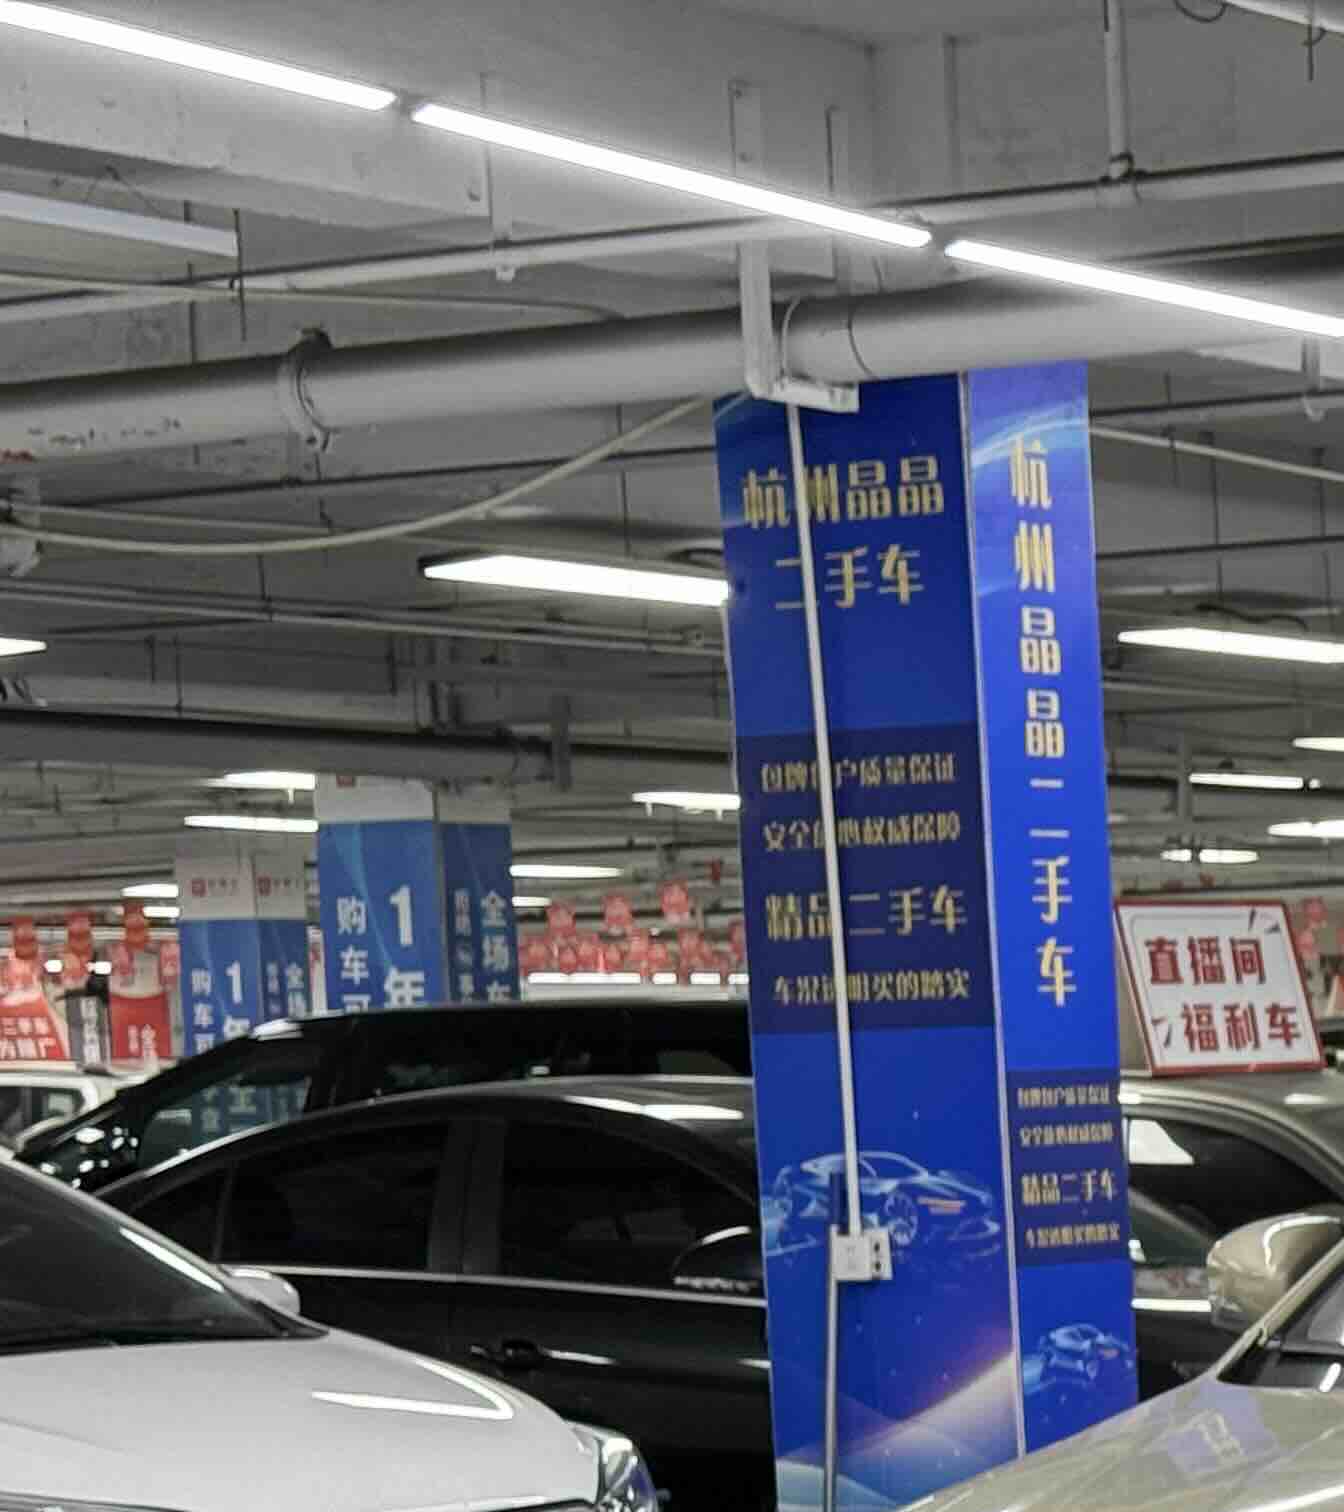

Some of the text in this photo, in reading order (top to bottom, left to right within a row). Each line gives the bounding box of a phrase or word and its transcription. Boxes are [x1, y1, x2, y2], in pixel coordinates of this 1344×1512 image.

[743, 455, 945, 529] 杭州晶晶
[775, 543, 924, 609] 二手车
[1009, 438, 1076, 1007] 杭州晶晶二手车
[766, 885, 968, 941] 精品二手车
[1144, 936, 1266, 985] 直播间
[1181, 1002, 1301, 1052] 福利车
